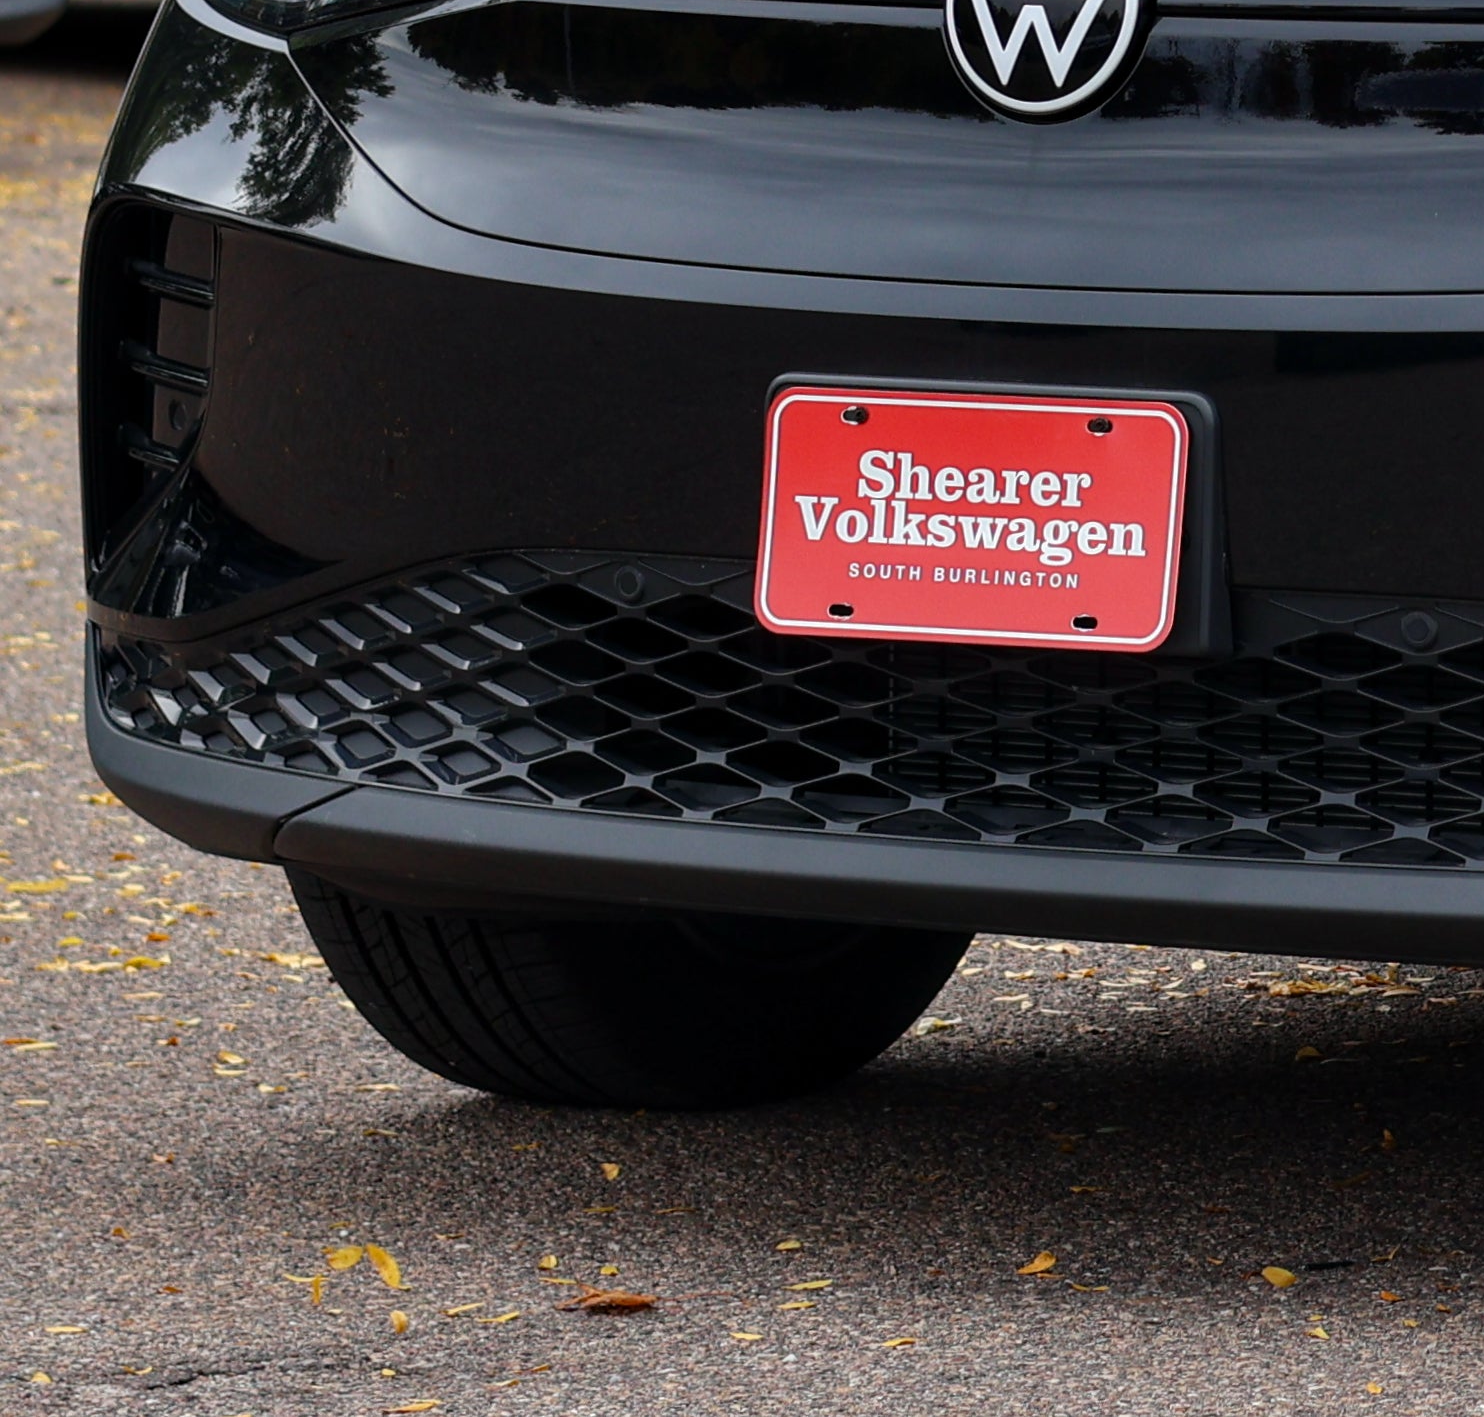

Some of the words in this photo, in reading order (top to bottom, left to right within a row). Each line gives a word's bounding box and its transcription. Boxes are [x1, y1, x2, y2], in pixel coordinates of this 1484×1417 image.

[857, 450, 1092, 508] Shearer
[795, 494, 1146, 566] Volkswagen
[848, 562, 922, 581] SOUTH
[934, 566, 1080, 589] BURLINGTON
